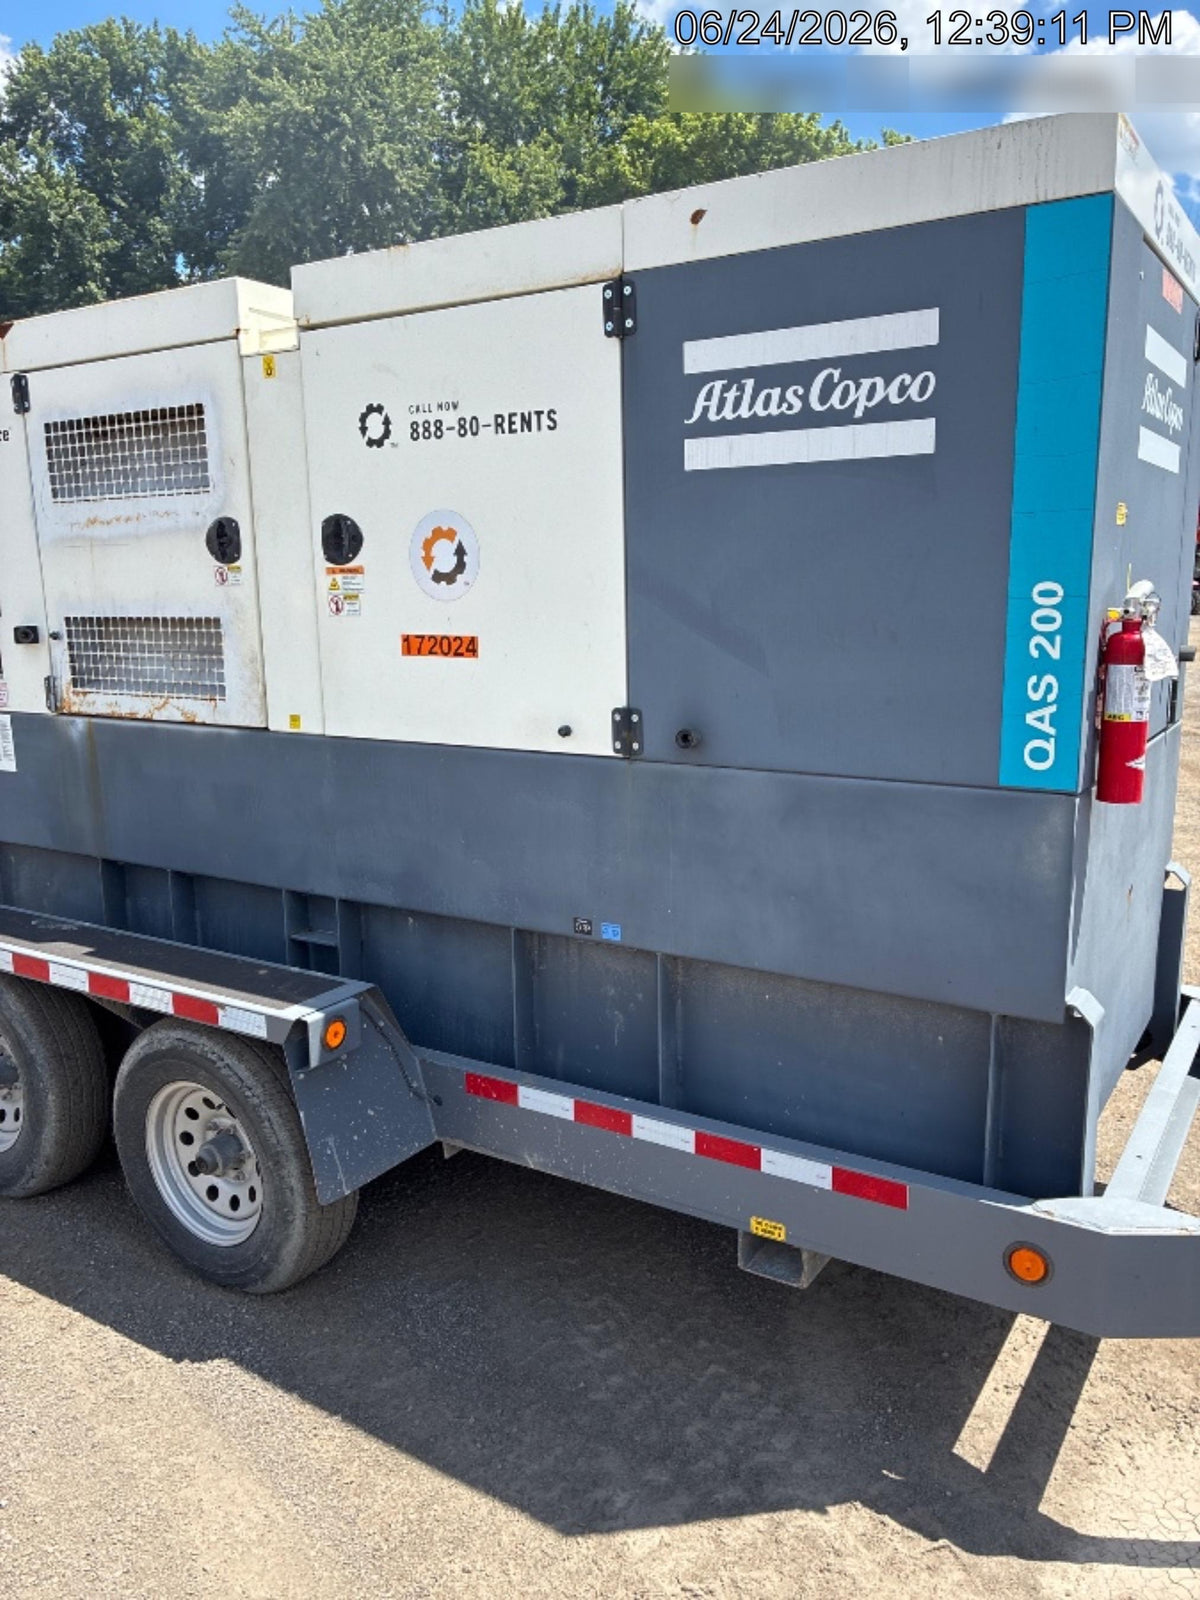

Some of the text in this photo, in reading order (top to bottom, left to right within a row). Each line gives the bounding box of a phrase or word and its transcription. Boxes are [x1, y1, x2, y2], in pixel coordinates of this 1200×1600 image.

[409, 400, 459, 414] CALL NOW
[684, 368, 936, 424] Atlas Copco
[410, 409, 557, 441] 888-80-RENTS
[402, 635, 477, 657] 172024
[1023, 581, 1064, 770] QAS 200
